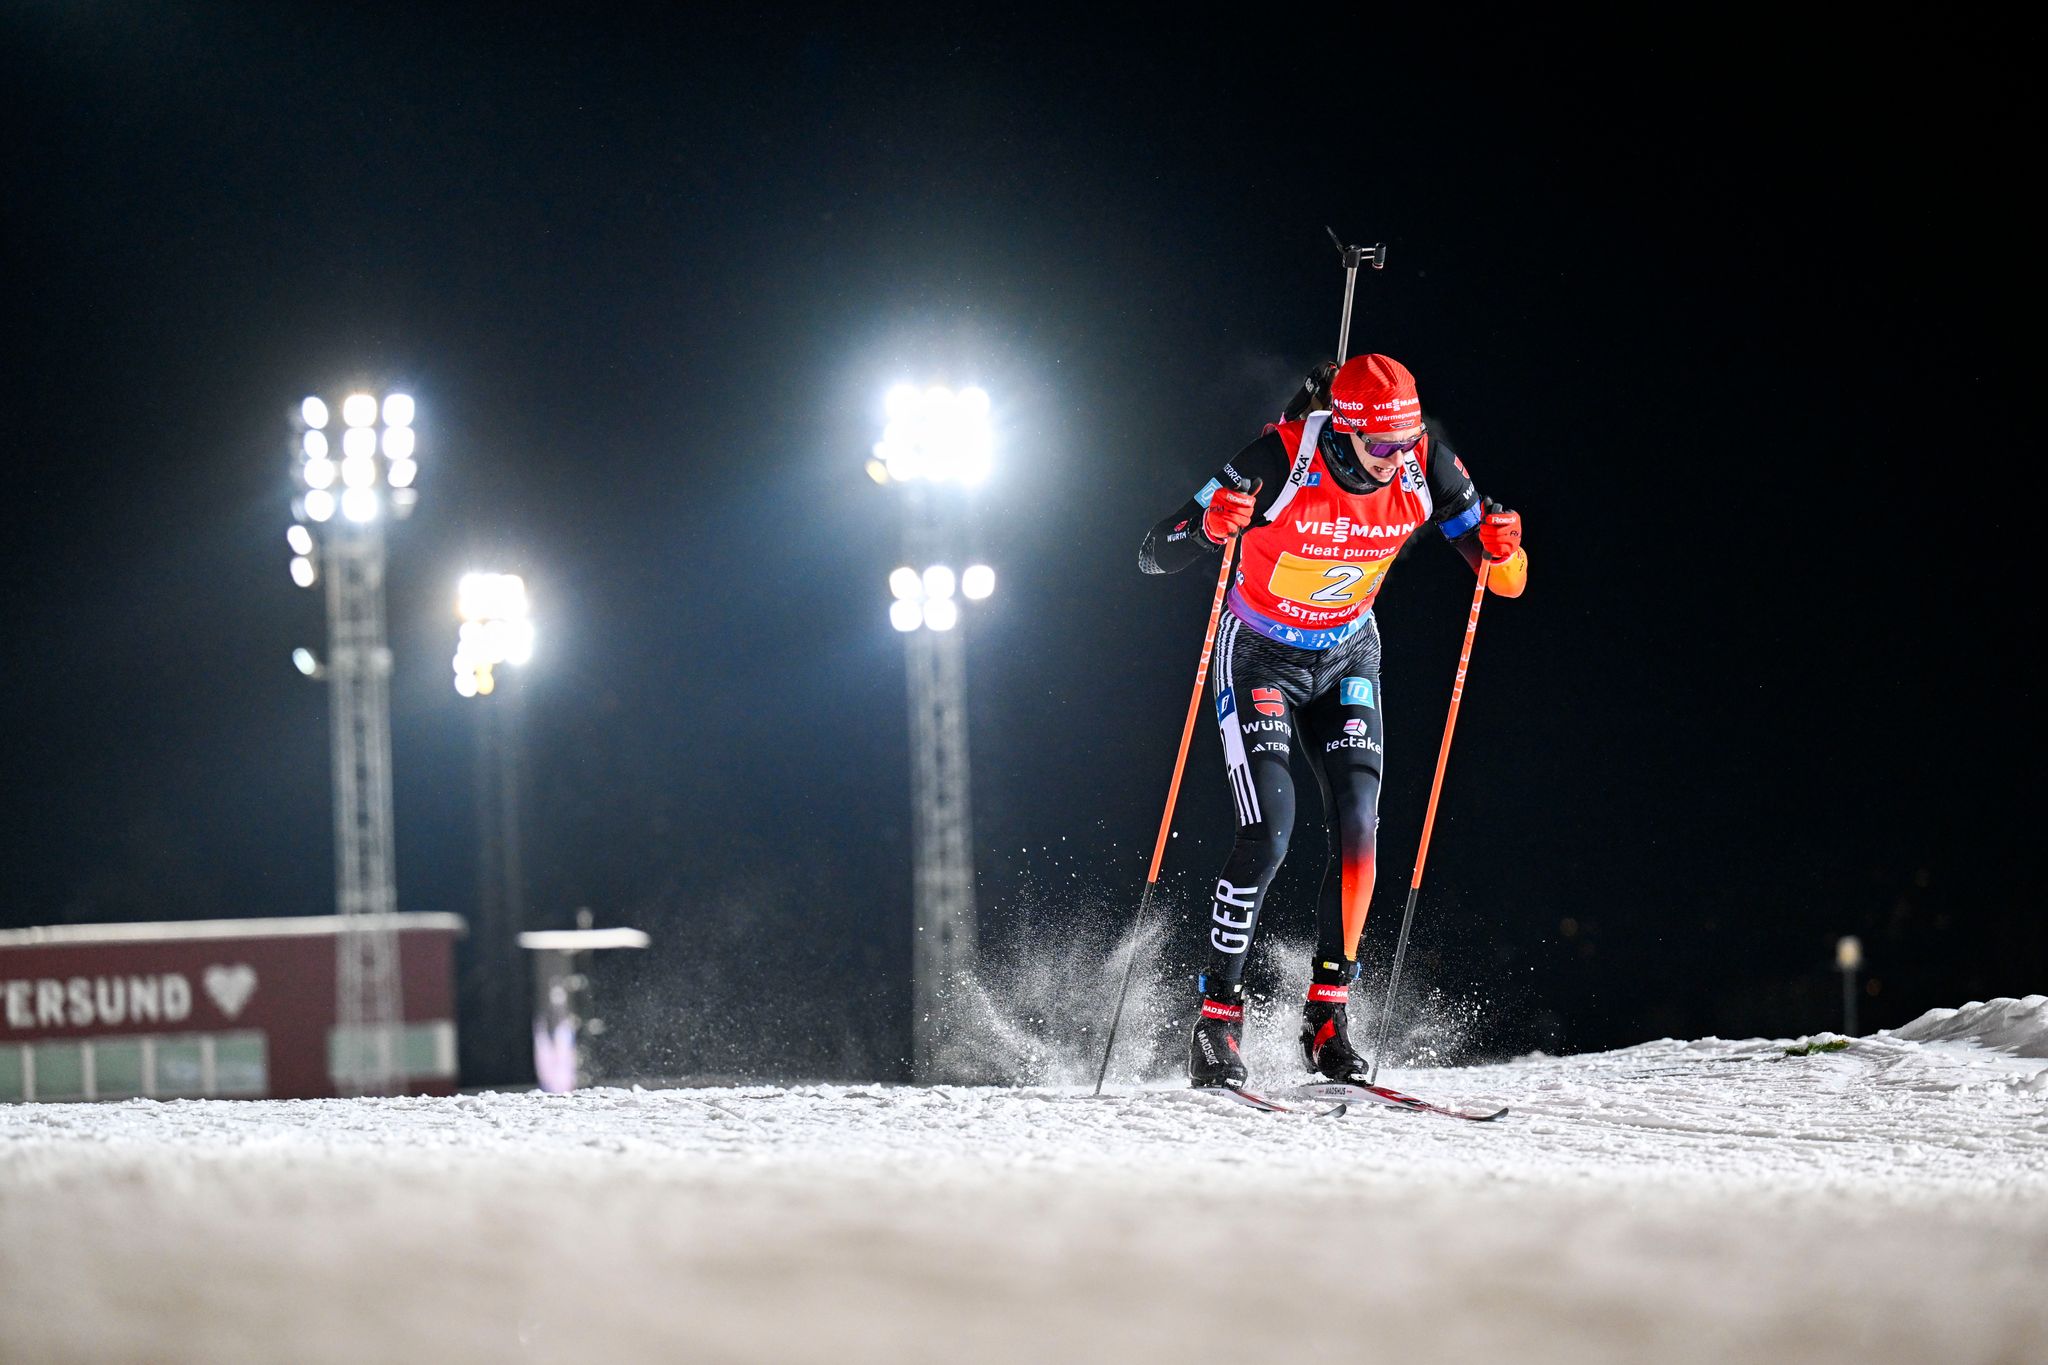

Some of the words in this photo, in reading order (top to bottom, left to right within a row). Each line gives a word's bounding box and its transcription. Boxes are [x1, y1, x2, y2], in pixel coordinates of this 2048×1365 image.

[1339, 400, 1364, 411] testo
[1290, 457, 1309, 487] JOKA
[1405, 460, 1424, 489] JOKA
[1295, 517, 1416, 543] VIESSMANN
[1301, 543, 1340, 557] Heat
[1343, 546, 1396, 559] pumps
[1310, 565, 1364, 602] 2
[1326, 736, 1381, 755] tectake
[1211, 879, 1259, 954] GER
[0, 973, 192, 1030] ERSUND
